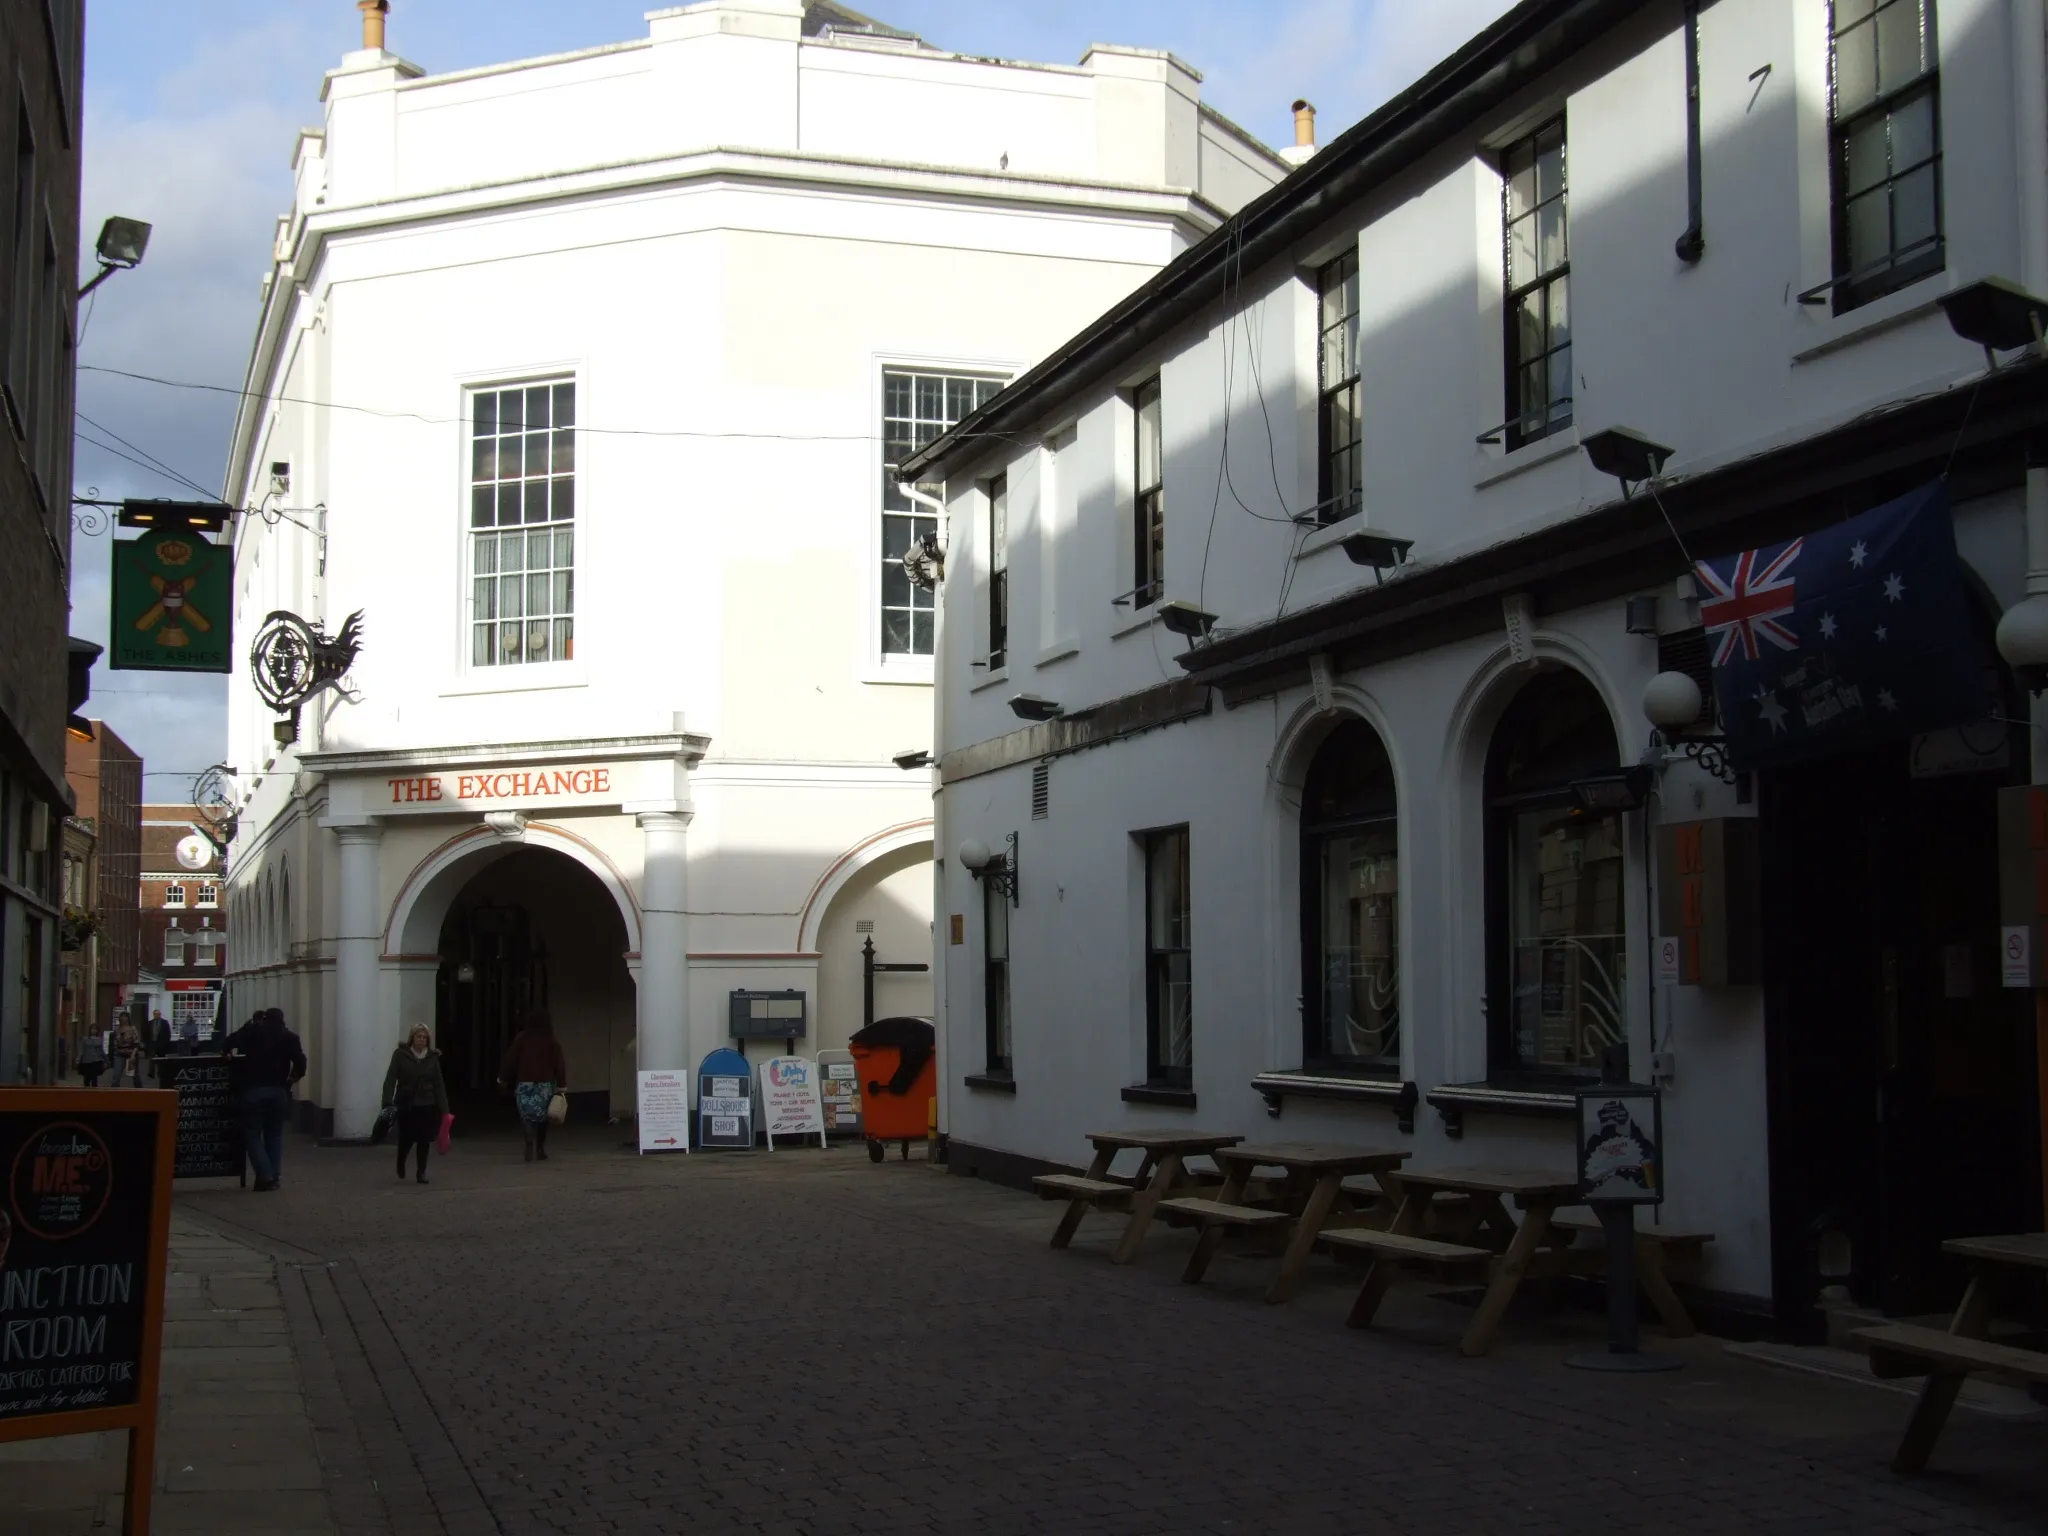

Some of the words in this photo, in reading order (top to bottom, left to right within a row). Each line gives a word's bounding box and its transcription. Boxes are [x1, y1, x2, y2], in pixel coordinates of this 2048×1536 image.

[123, 649, 155, 661] THE
[164, 649, 221, 662] ASHES
[388, 778, 442, 802] THE
[457, 769, 611, 799] EXCHANGE
[174, 1065, 230, 1081] ASHES
[714, 1120, 736, 1132] SHOP
[2, 1314, 107, 1361] ROOM
[0, 1368, 45, 1390] ARTIES
[50, 1364, 105, 1386] CATERED
[110, 1360, 134, 1381] FOR
